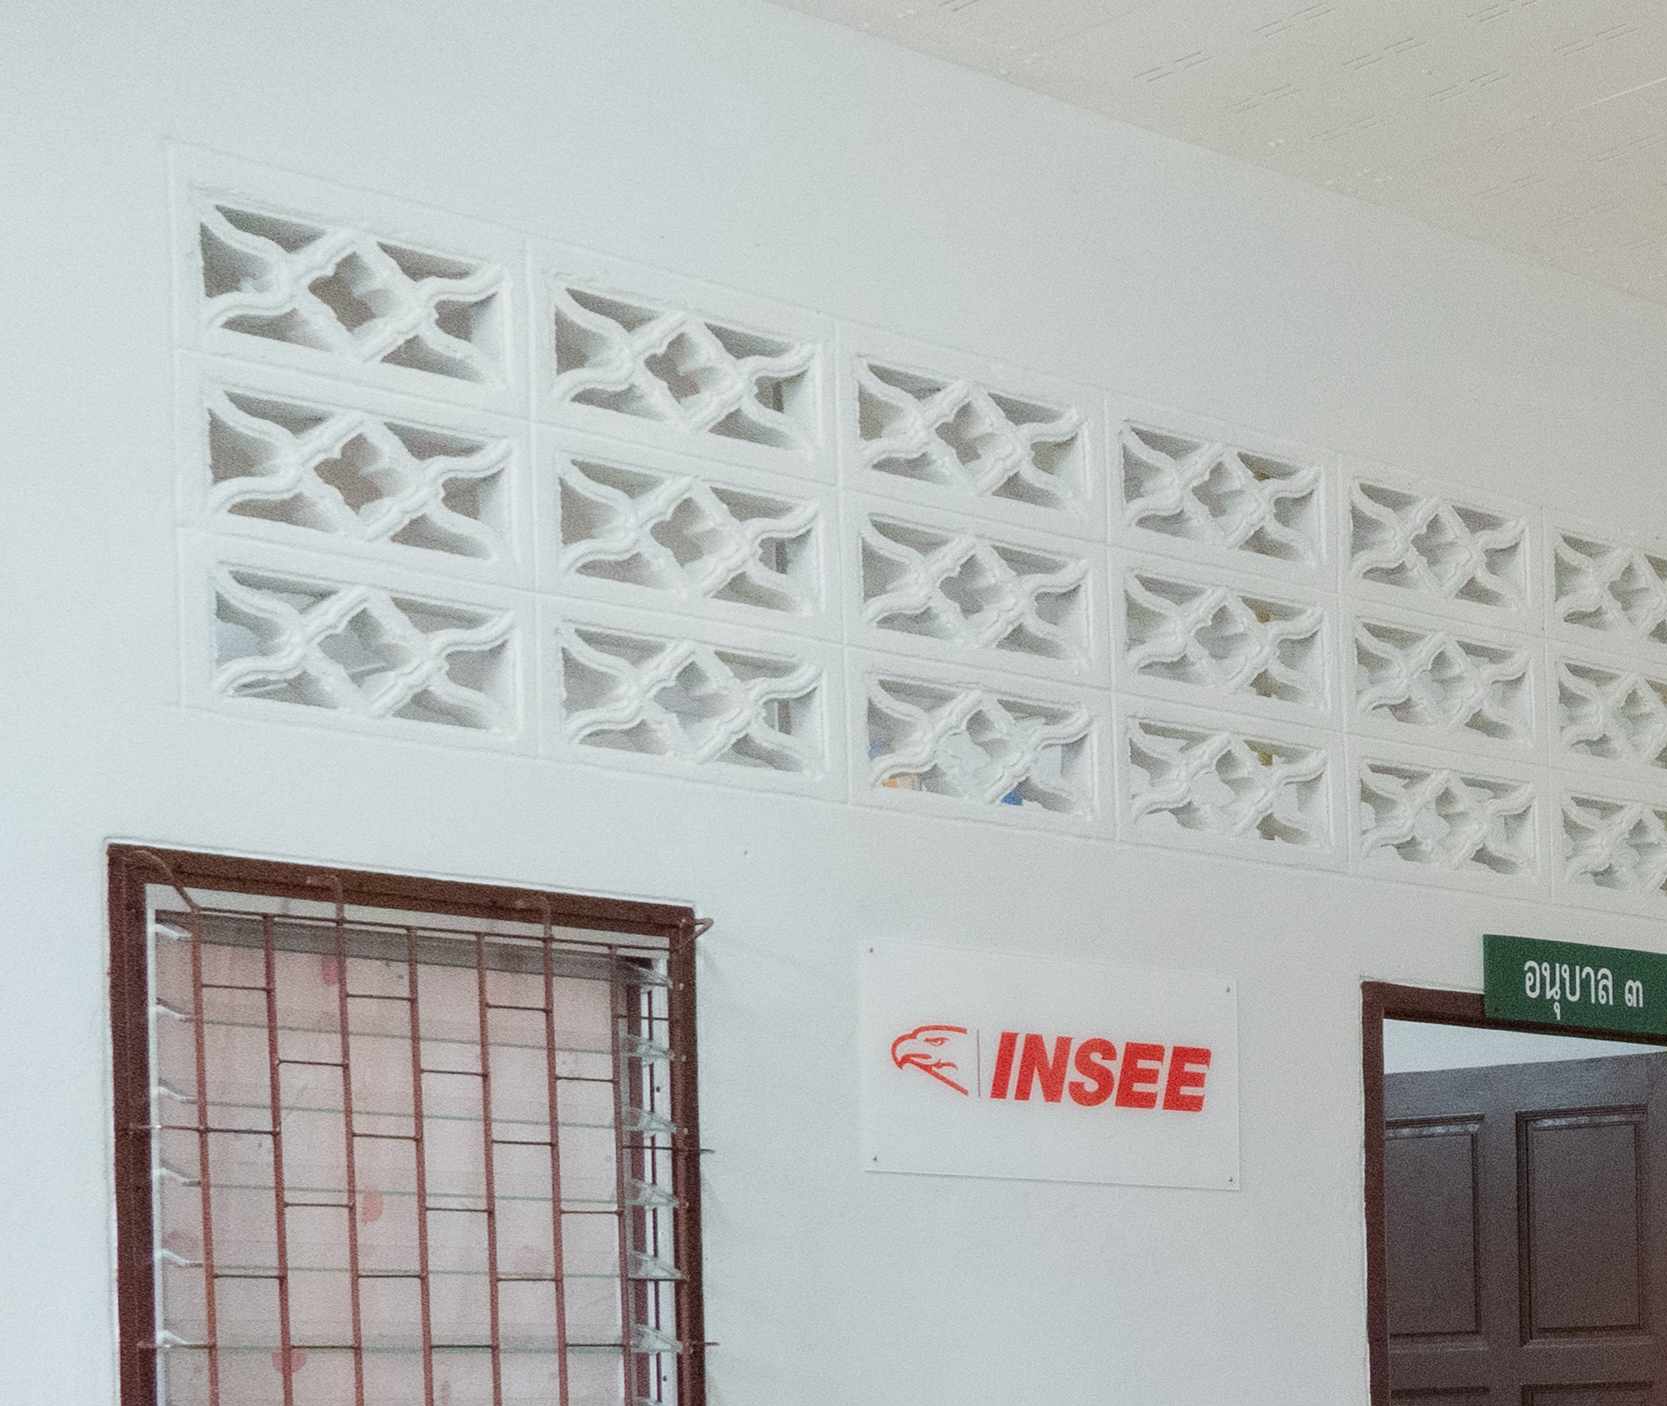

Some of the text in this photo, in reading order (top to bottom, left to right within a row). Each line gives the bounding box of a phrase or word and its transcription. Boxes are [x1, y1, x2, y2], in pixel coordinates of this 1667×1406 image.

[1524, 960, 1644, 1021] อนุบาล ๓
[991, 1032, 1212, 1112] INSEE
